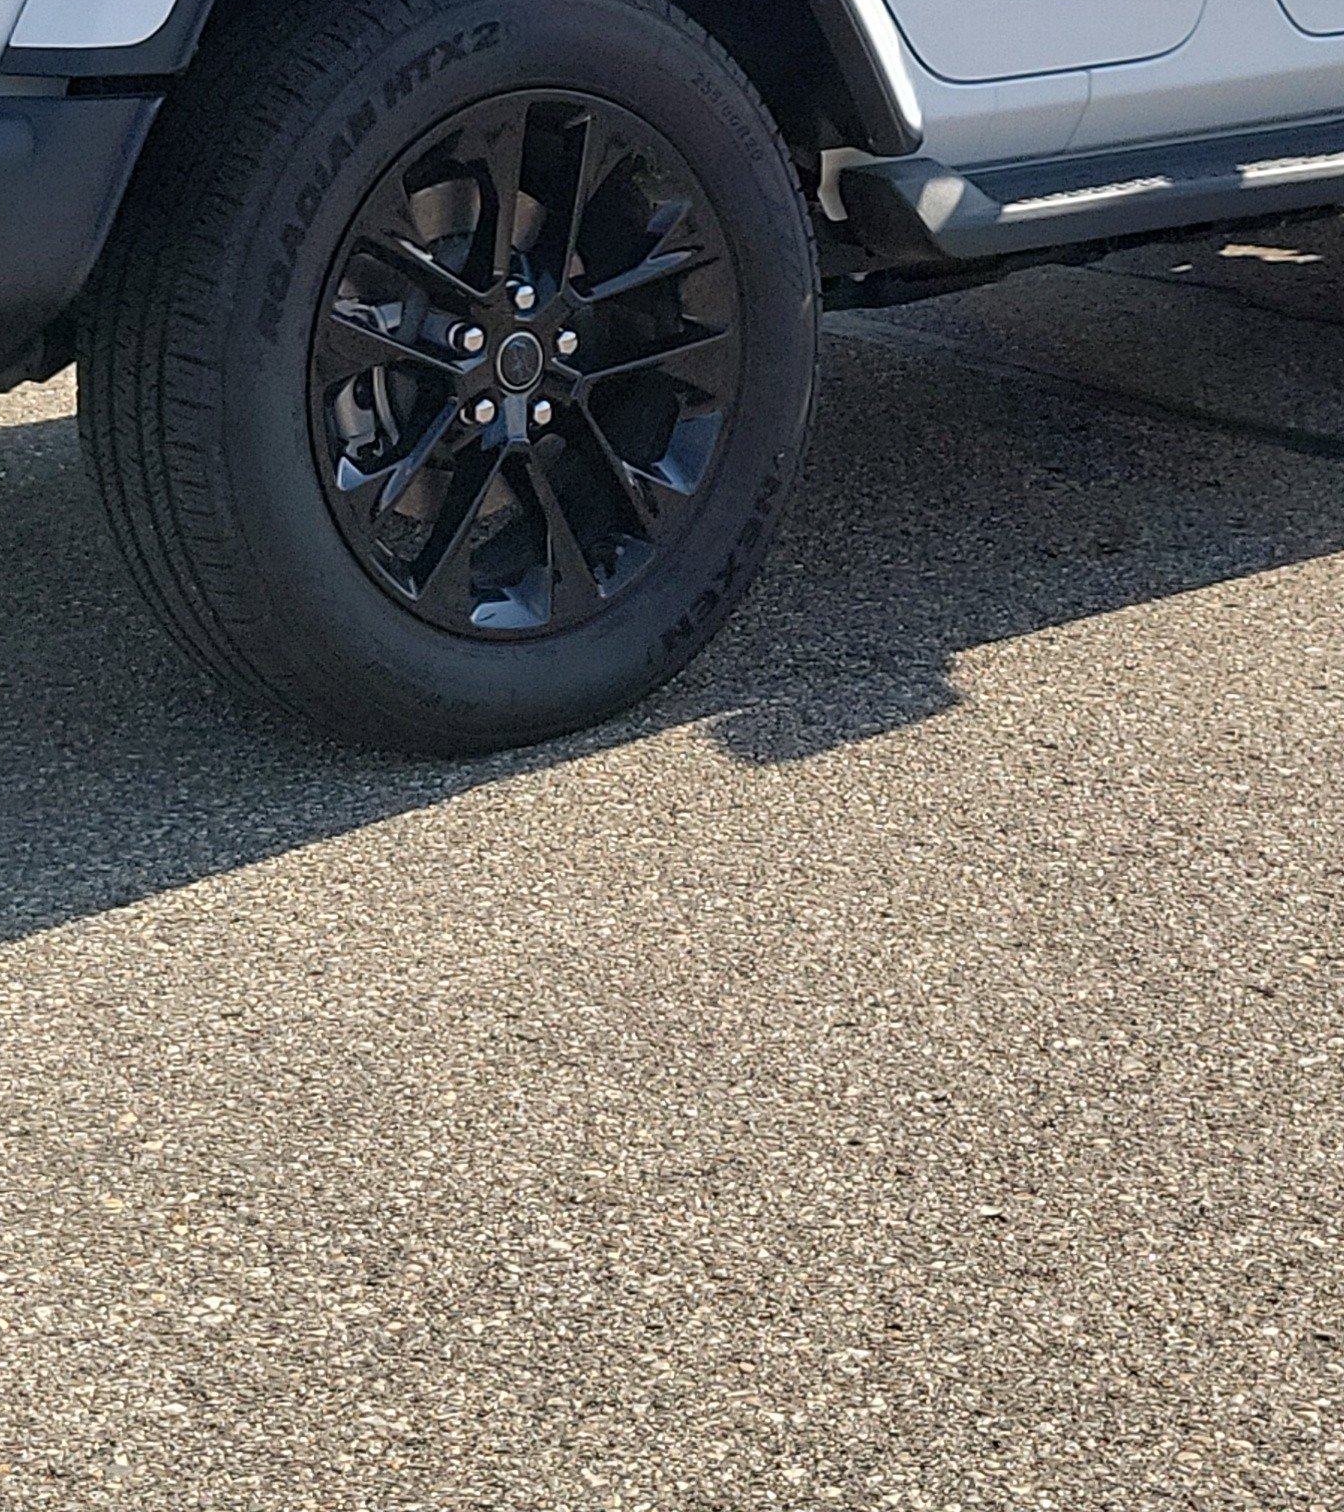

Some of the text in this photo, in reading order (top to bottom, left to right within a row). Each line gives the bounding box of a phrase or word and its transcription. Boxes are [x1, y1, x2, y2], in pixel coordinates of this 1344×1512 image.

[259, 21, 500, 341] ROADIAN HTX2
[663, 477, 781, 665] NEXEN
